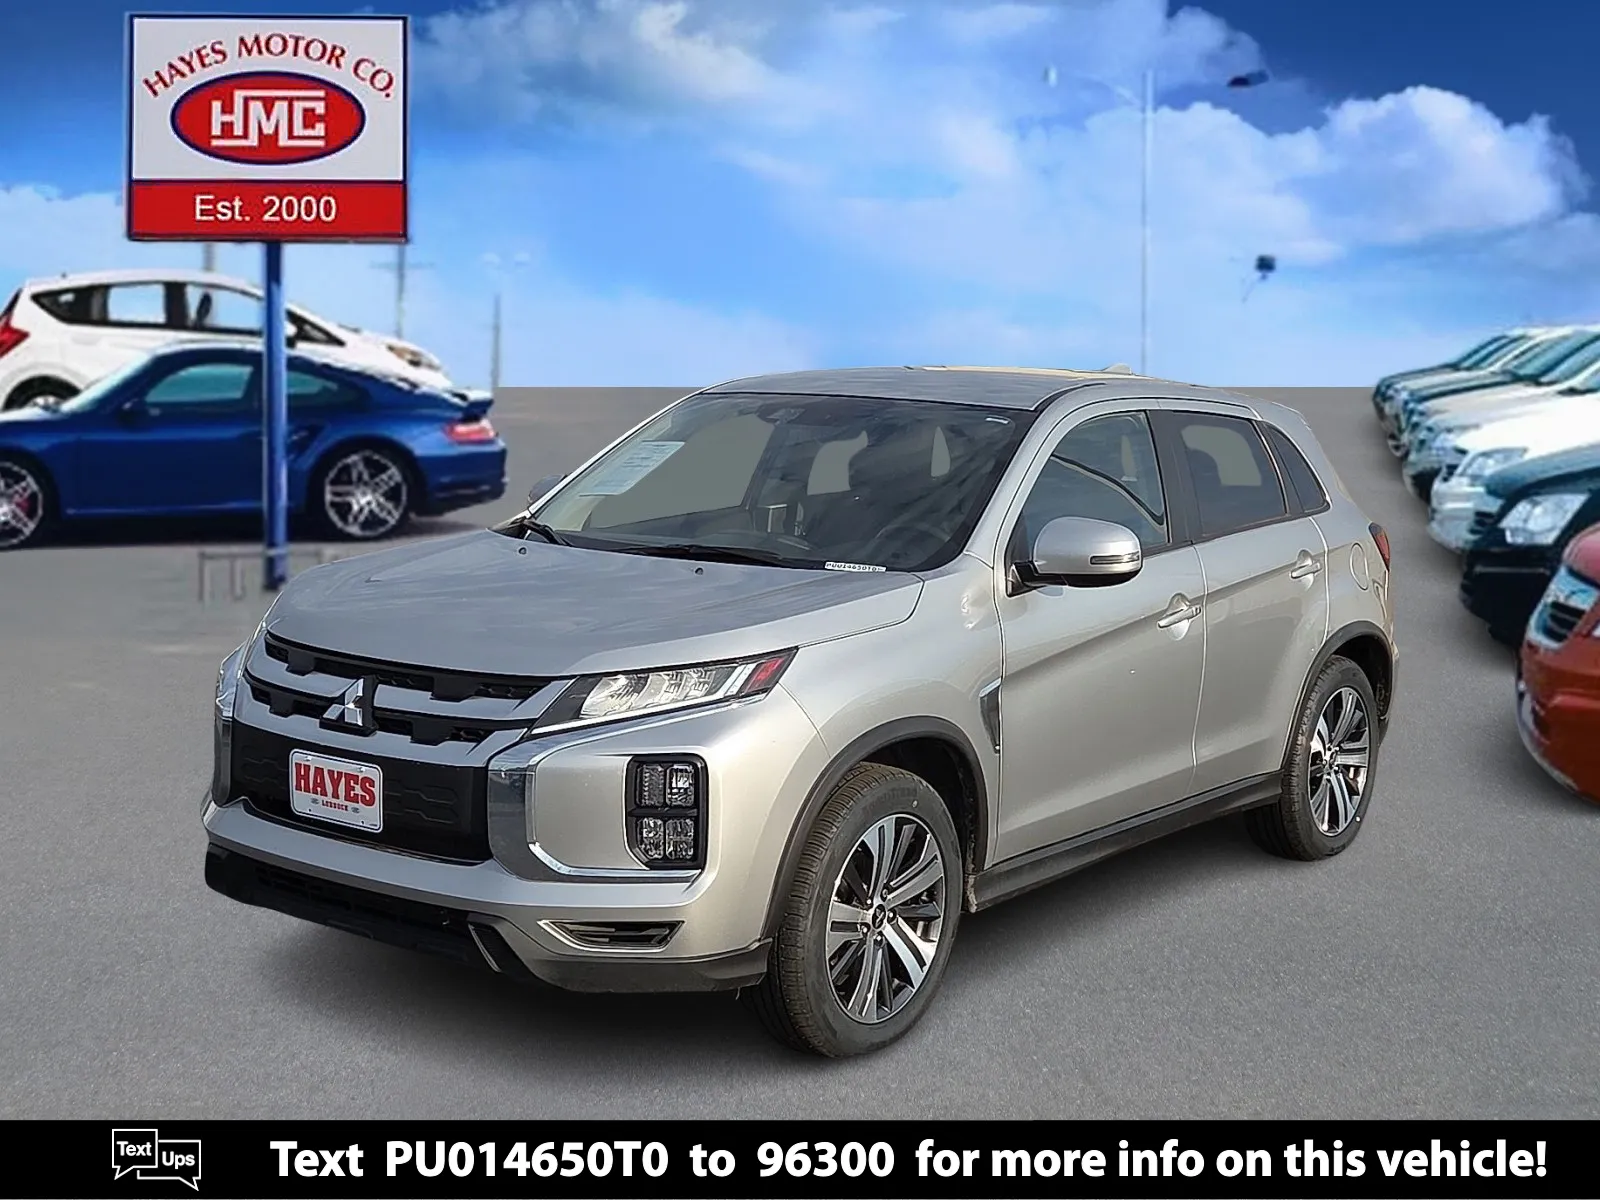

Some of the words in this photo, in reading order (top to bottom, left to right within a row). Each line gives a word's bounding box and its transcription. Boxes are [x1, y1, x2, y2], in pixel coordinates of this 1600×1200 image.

[142, 40, 229, 97] HAYES
[237, 32, 346, 69] MOTOR
[352, 57, 395, 98] CO.
[210, 89, 326, 147] HMC
[195, 195, 250, 222] Est.
[262, 195, 337, 222] 2000
[294, 762, 376, 807] HAYES
